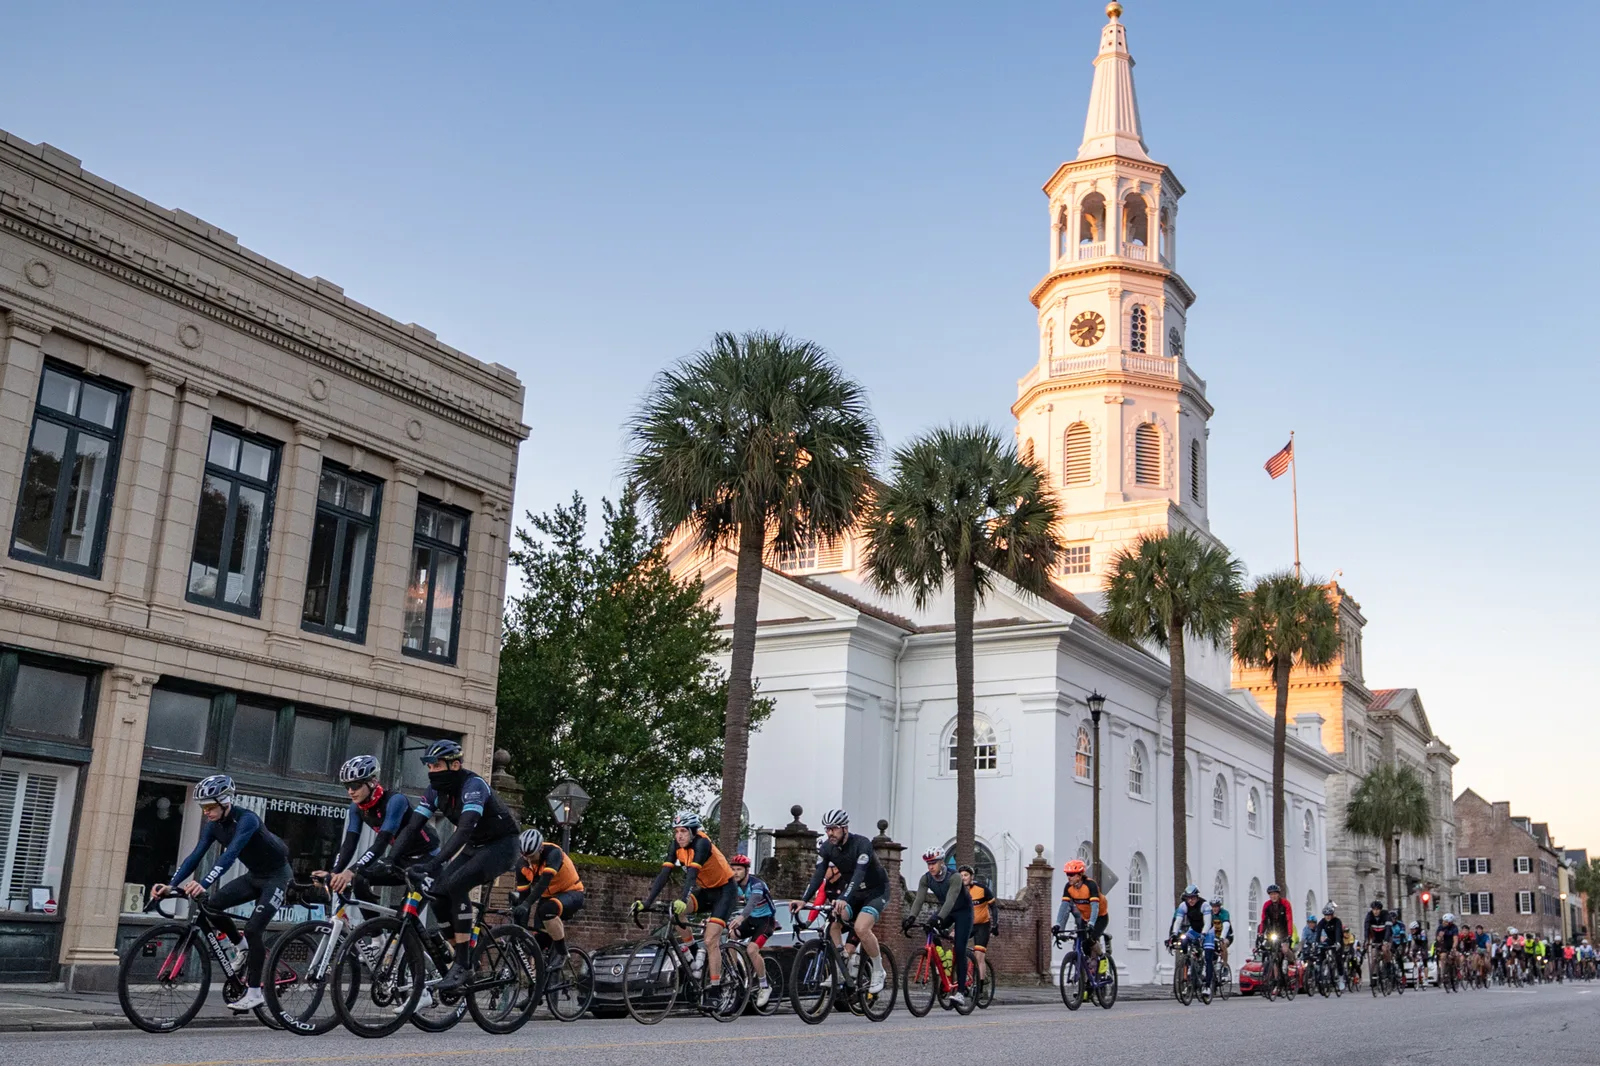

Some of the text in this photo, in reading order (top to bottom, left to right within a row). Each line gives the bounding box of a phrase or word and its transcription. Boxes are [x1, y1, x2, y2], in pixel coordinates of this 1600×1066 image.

[357, 851, 375, 866] USA
[205, 865, 224, 884] USA
[207, 932, 234, 977] cannondale
[280, 1010, 316, 1031] roval
